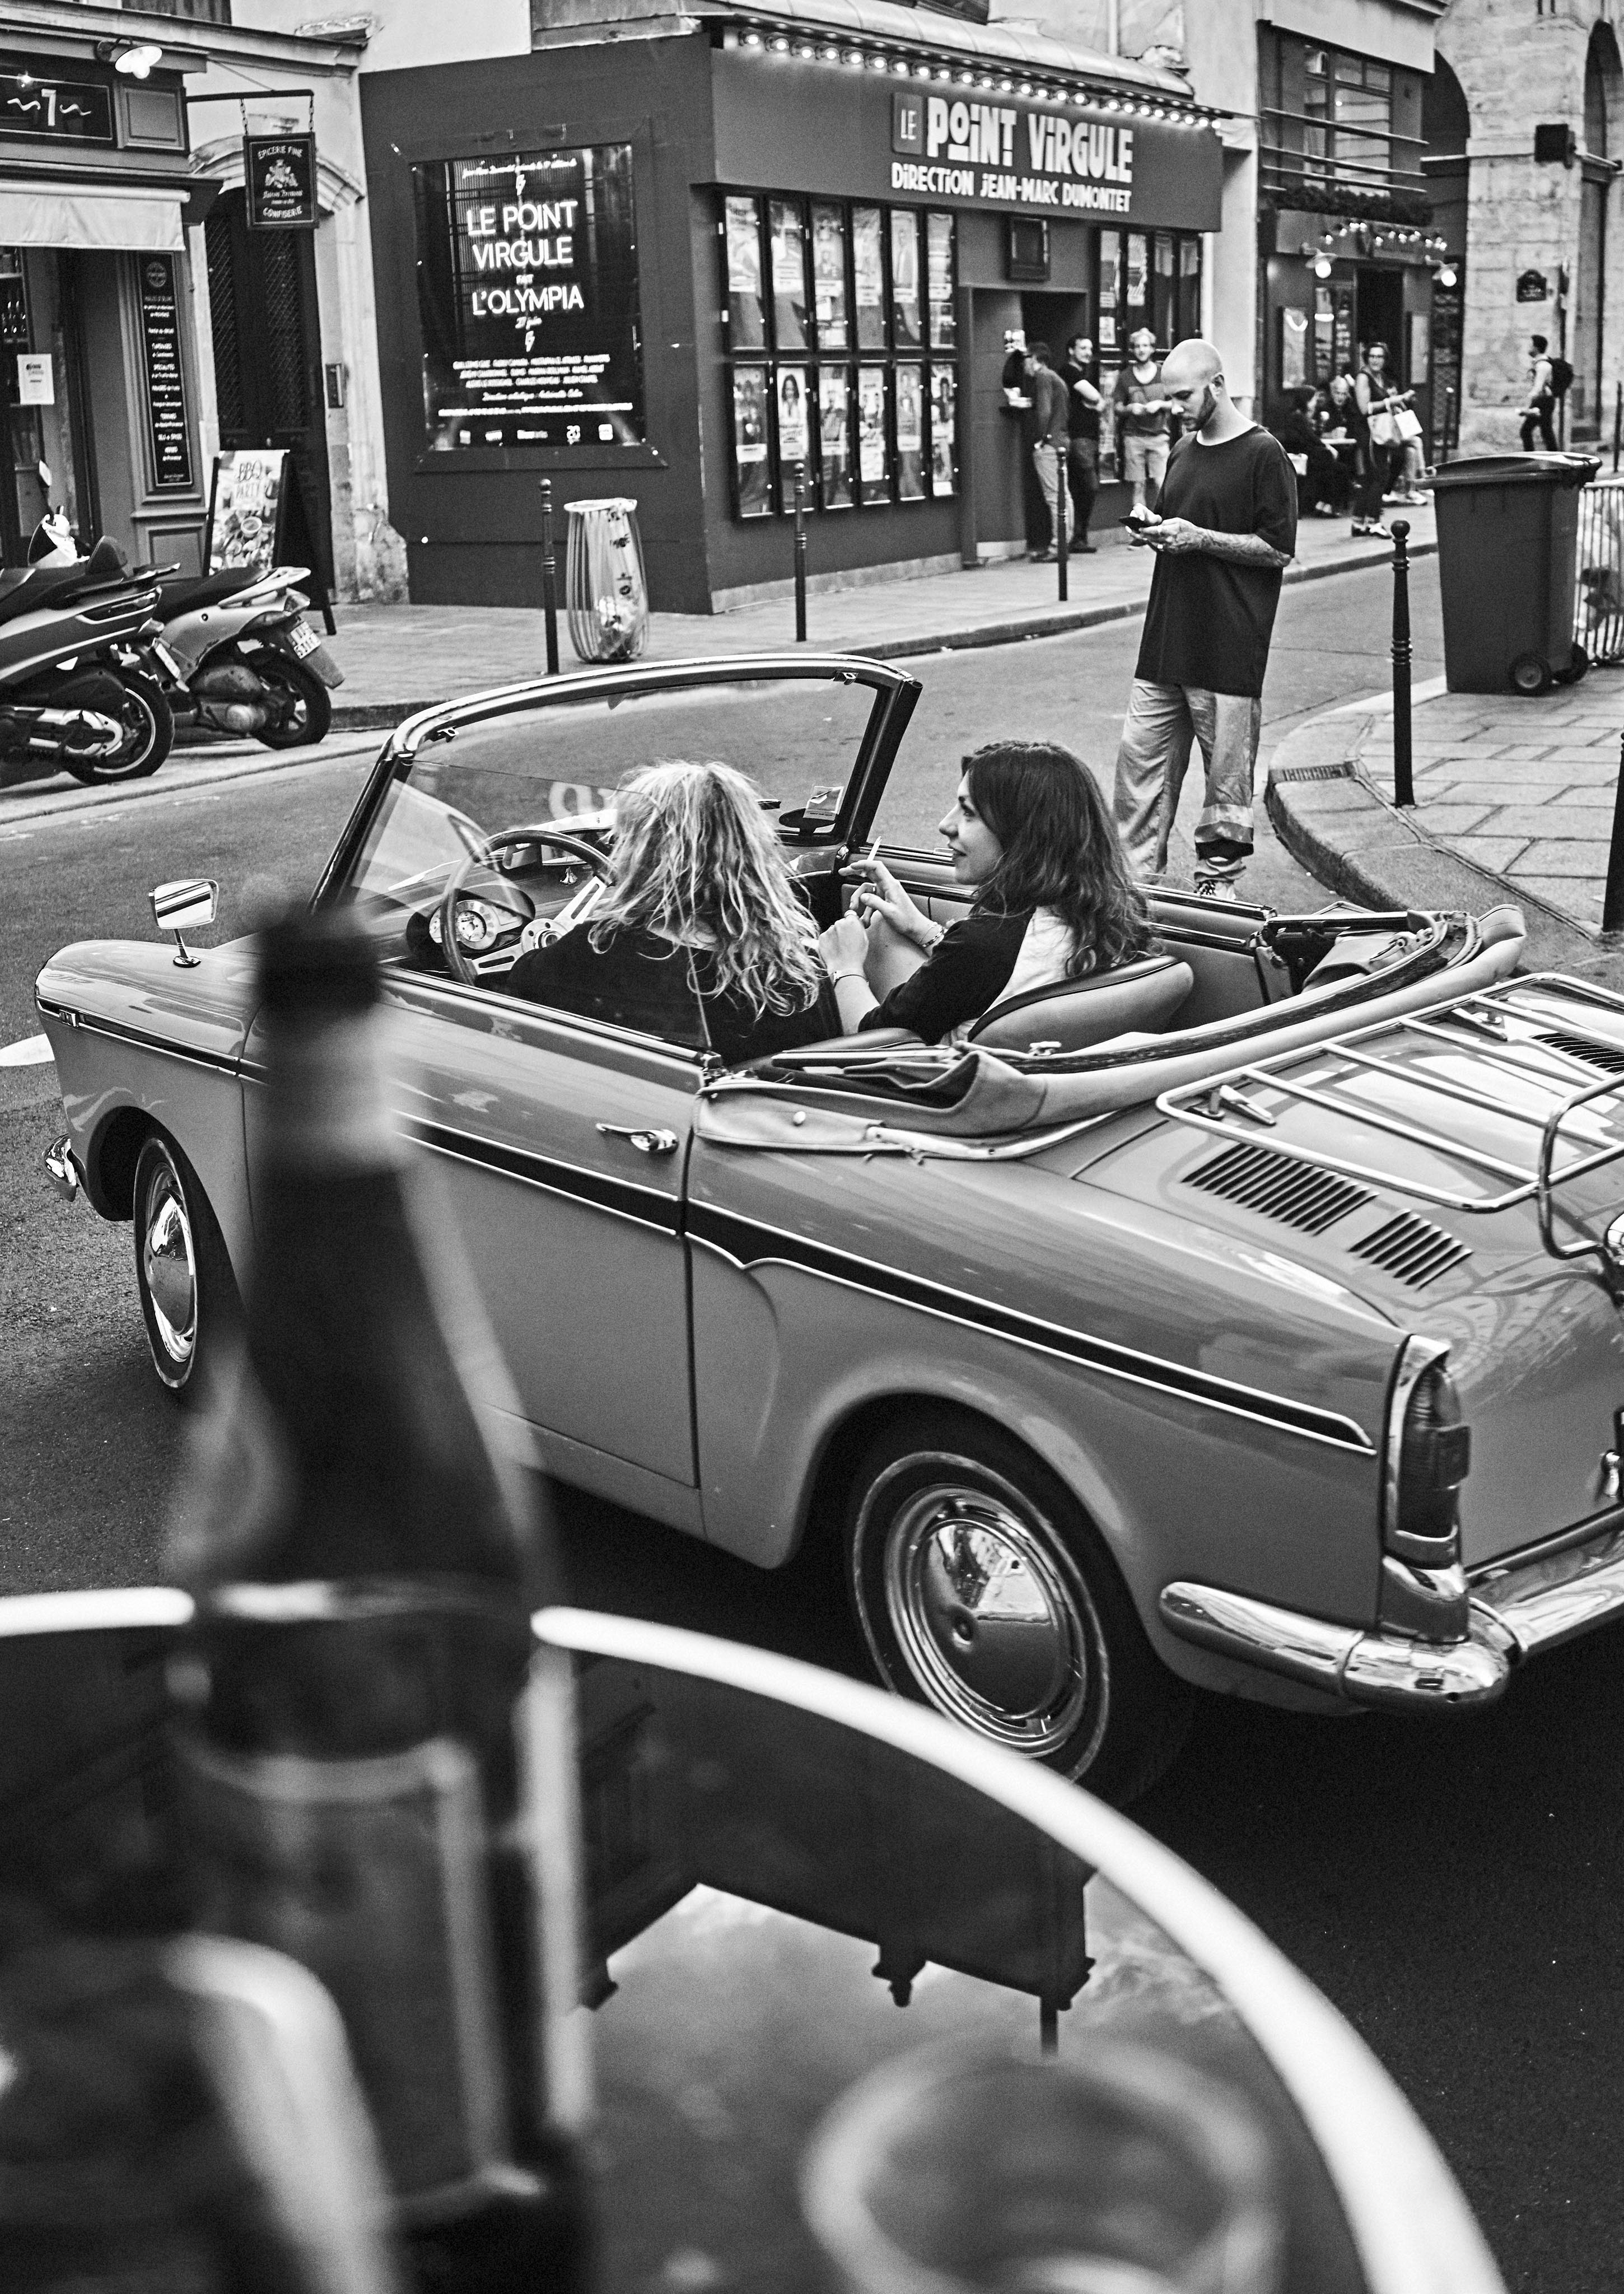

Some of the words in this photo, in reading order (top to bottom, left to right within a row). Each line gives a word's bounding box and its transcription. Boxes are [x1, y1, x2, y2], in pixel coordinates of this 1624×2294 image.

[900, 108, 917, 141] LE
[1062, 183, 1132, 212] DUMONTET
[466, 207, 496, 236] LE
[503, 201, 578, 233] POINT
[472, 236, 573, 269] VIRGULE
[472, 285, 585, 316] L'OLYMPIA
[237, 460, 262, 482] BBQ
